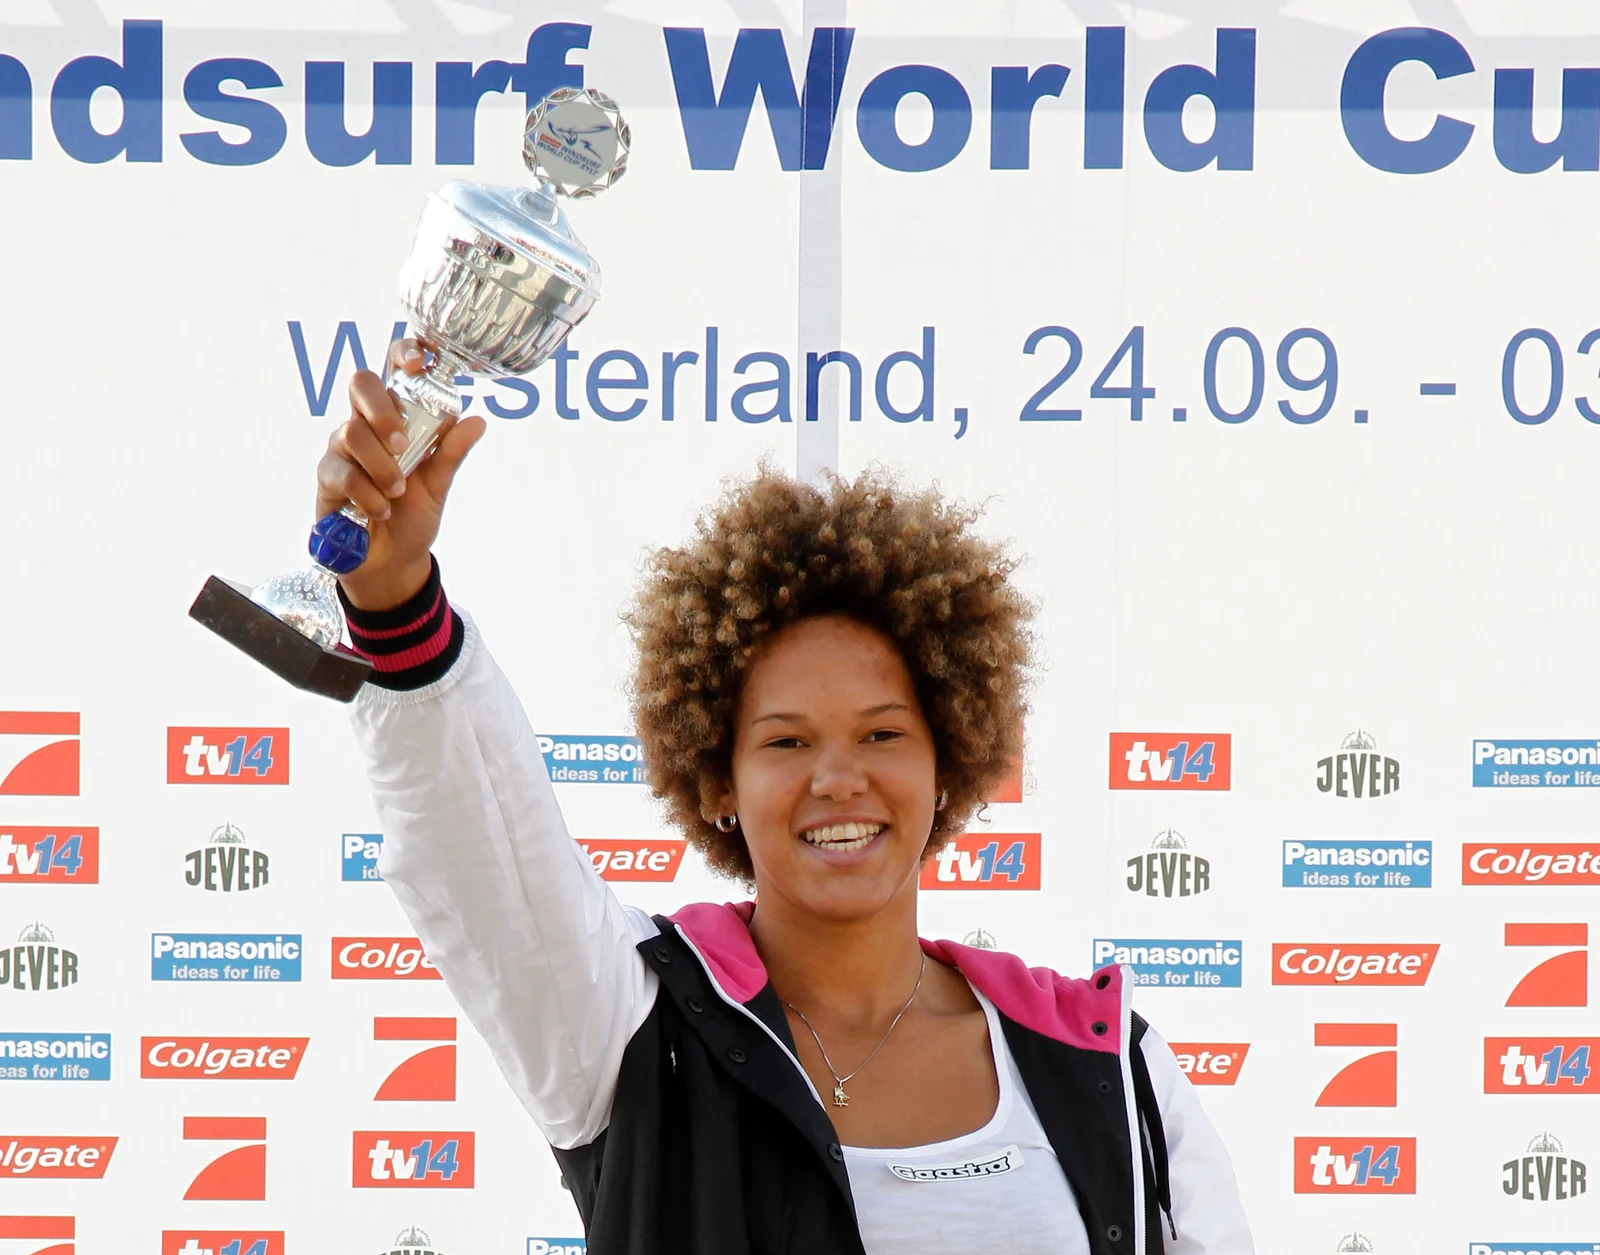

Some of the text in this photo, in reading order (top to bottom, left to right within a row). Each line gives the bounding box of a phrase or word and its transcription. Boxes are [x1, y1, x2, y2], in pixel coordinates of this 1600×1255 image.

[663, 26, 1256, 172] World
[287, 321, 969, 440] Wsterland,
[1019, 325, 1369, 425] 24.09.
[1420, 383, 1456, 396] -
[184, 736, 275, 777] tv14
[552, 766, 628, 780] ideas for
[1126, 742, 1216, 783] tv14
[1316, 753, 1400, 799] JEVER
[1491, 769, 1541, 785] ideas
[1543, 769, 1572, 785] for
[185, 846, 269, 892] JEVER
[592, 846, 670, 875] gate
[935, 841, 1026, 882] tv14
[1285, 843, 1429, 868] Panasonic
[1126, 852, 1210, 898] JEVER
[1301, 869, 1412, 885] ideas for life
[155, 938, 299, 961] Panasonic
[1096, 942, 1239, 966] Panasonic
[1280, 949, 1421, 982] Colgate
[171, 962, 282, 978] ideas for life
[1164, 970, 1221, 985] for life
[31, 1062, 91, 1077] for life
[149, 1042, 291, 1076] Colgate
[1501, 1046, 1592, 1087] tv14
[369, 1140, 460, 1181] tv14
[893, 1156, 1010, 1180] Gaastra
[1311, 1146, 1401, 1187] tv14
[1502, 1155, 1587, 1201] JEVER
